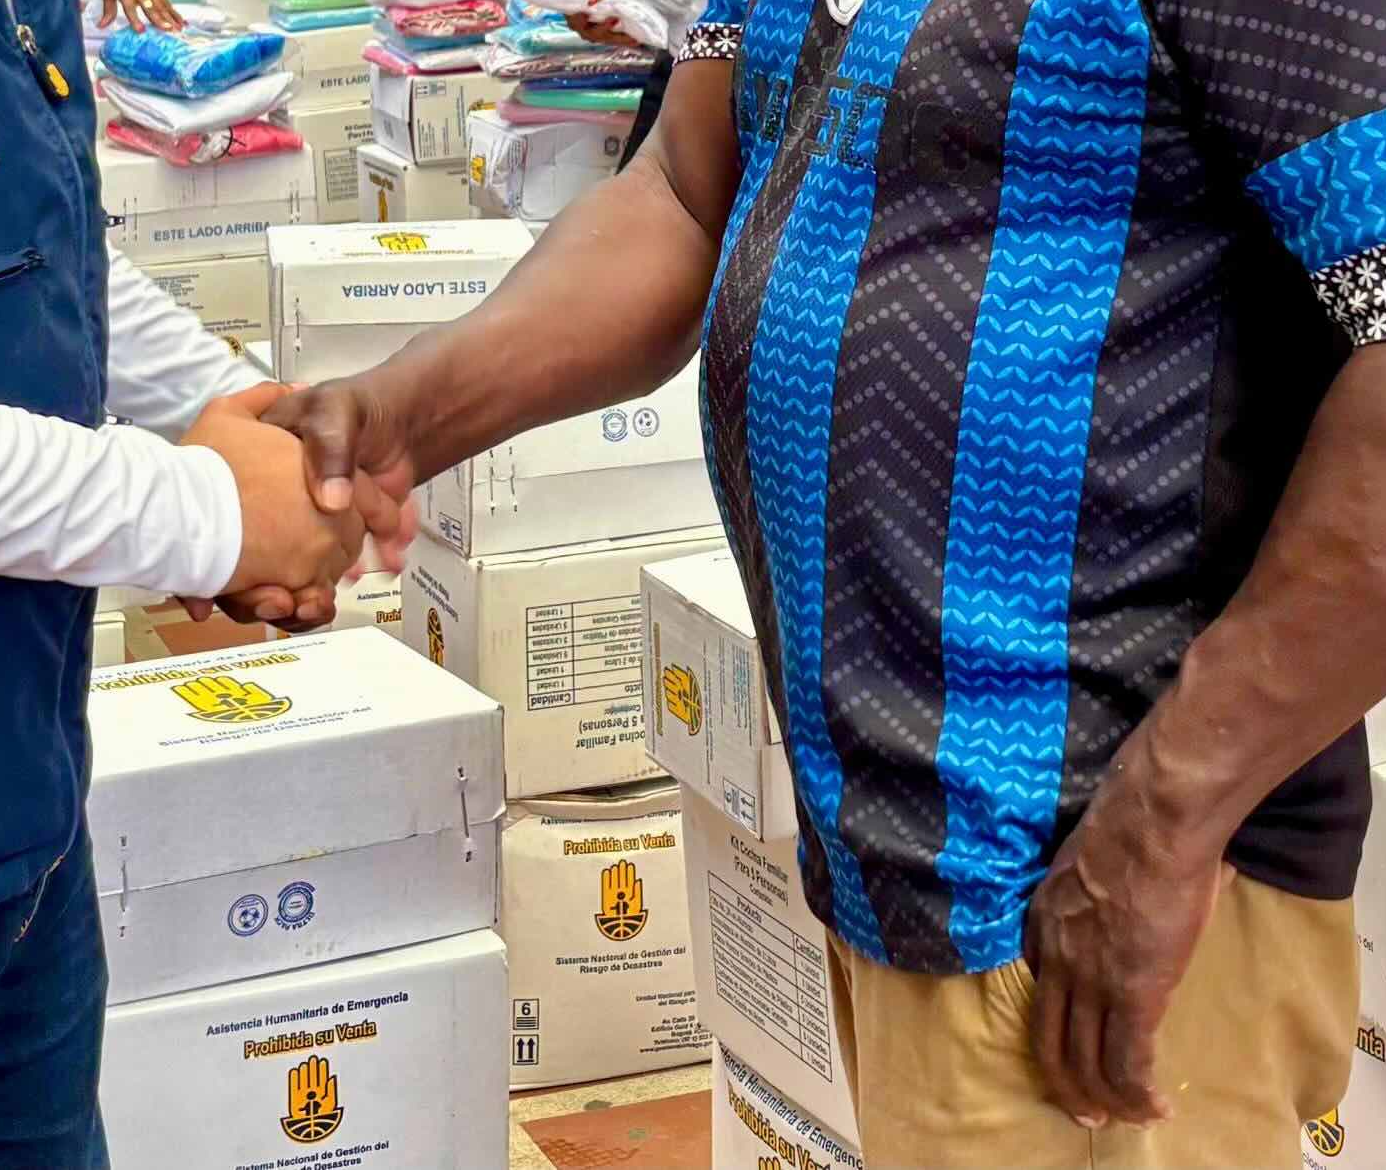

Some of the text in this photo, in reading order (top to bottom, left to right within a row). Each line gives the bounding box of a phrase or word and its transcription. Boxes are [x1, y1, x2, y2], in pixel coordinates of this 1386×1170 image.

[153, 221, 271, 241] ESTE LADO ARRIBA
[342, 280, 487, 298] ESTE LADO ARRIBA
[530, 692, 572, 707] Cantidad
[579, 716, 638, 734] 5 Personas)
[576, 734, 617, 749] Familiar
[564, 831, 676, 857] Prohibida su Venta
[555, 946, 686, 966] Sistema Nacional de Gestión del
[580, 958, 663, 975] Riesgo de Desastres
[206, 991, 409, 1036] Asistencia Humanitaria de Emergencia
[521, 1002, 532, 1016] 6
[243, 1018, 377, 1060] Prohibida su Venta
[276, 1151, 319, 1170] Nacional
[321, 1150, 333, 1160] de
[335, 1141, 372, 1159] Gestión
[374, 1140, 390, 1151] del
